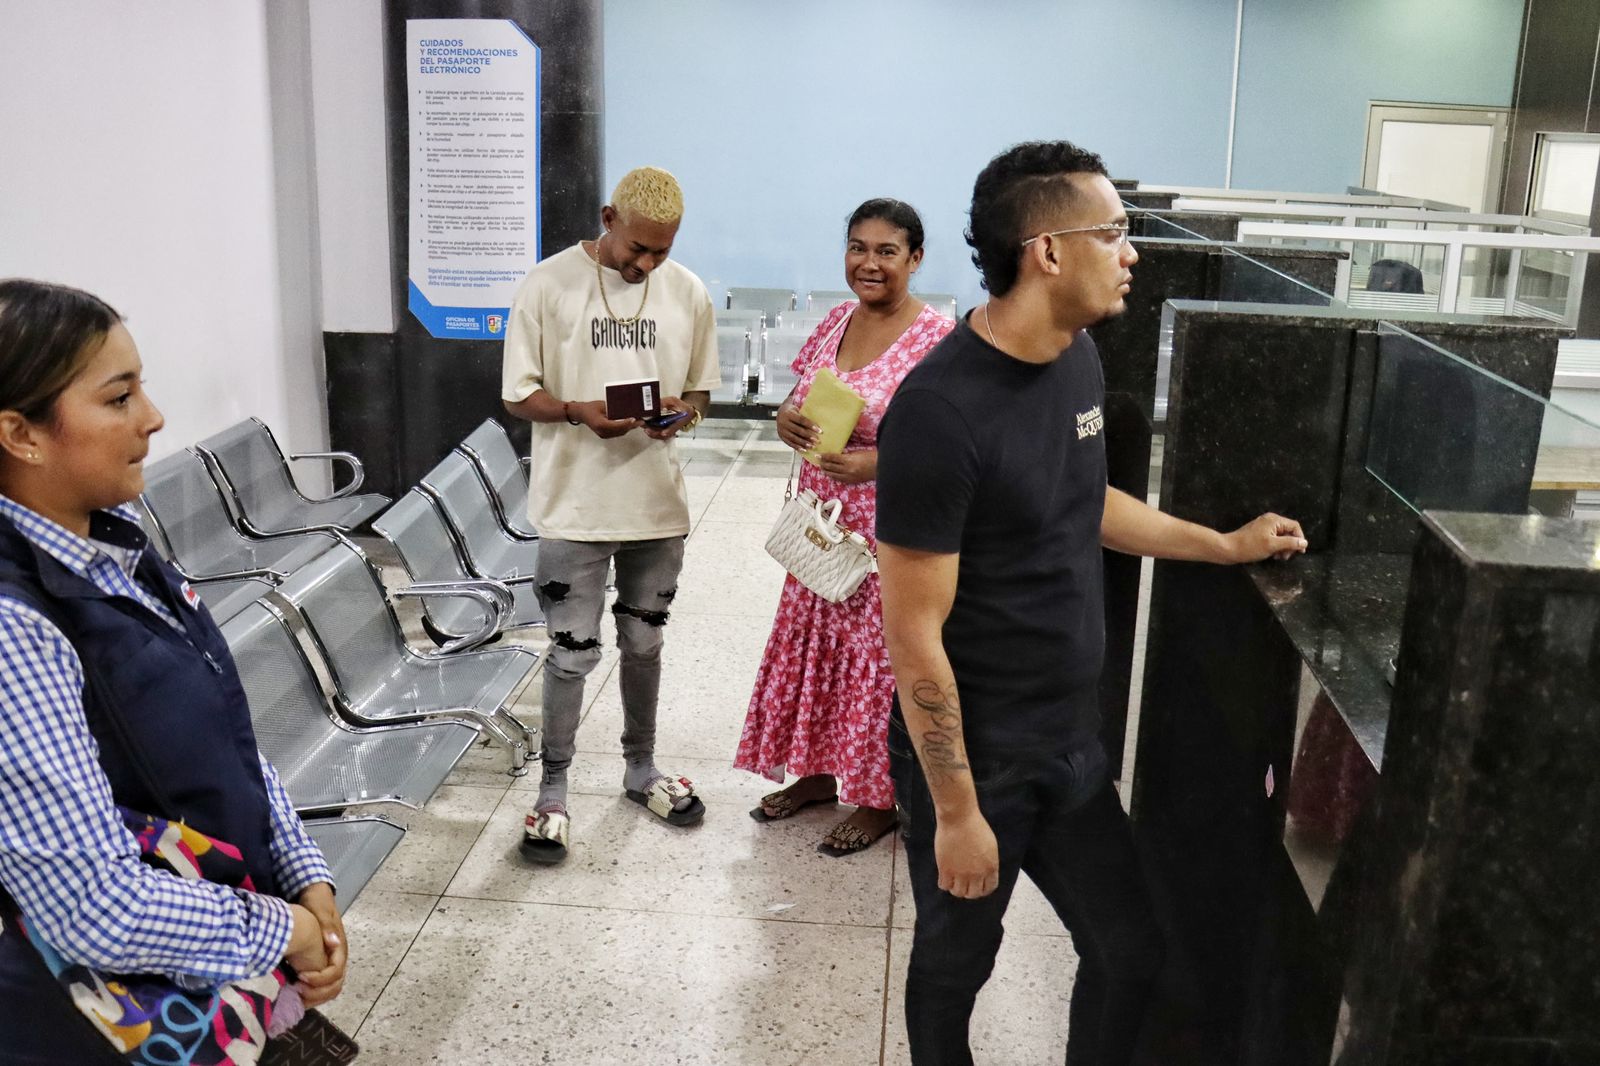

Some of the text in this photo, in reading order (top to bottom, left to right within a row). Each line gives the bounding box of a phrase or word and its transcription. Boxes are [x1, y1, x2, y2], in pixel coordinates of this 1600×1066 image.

[420, 39, 464, 47] CUIDADOS
[420, 48, 518, 57] Y RECOMENDACIONES
[420, 57, 491, 66] DEL PASAPORTE
[420, 65, 481, 74] ELECTRÓNICO
[591, 317, 657, 352] GANGSTER
